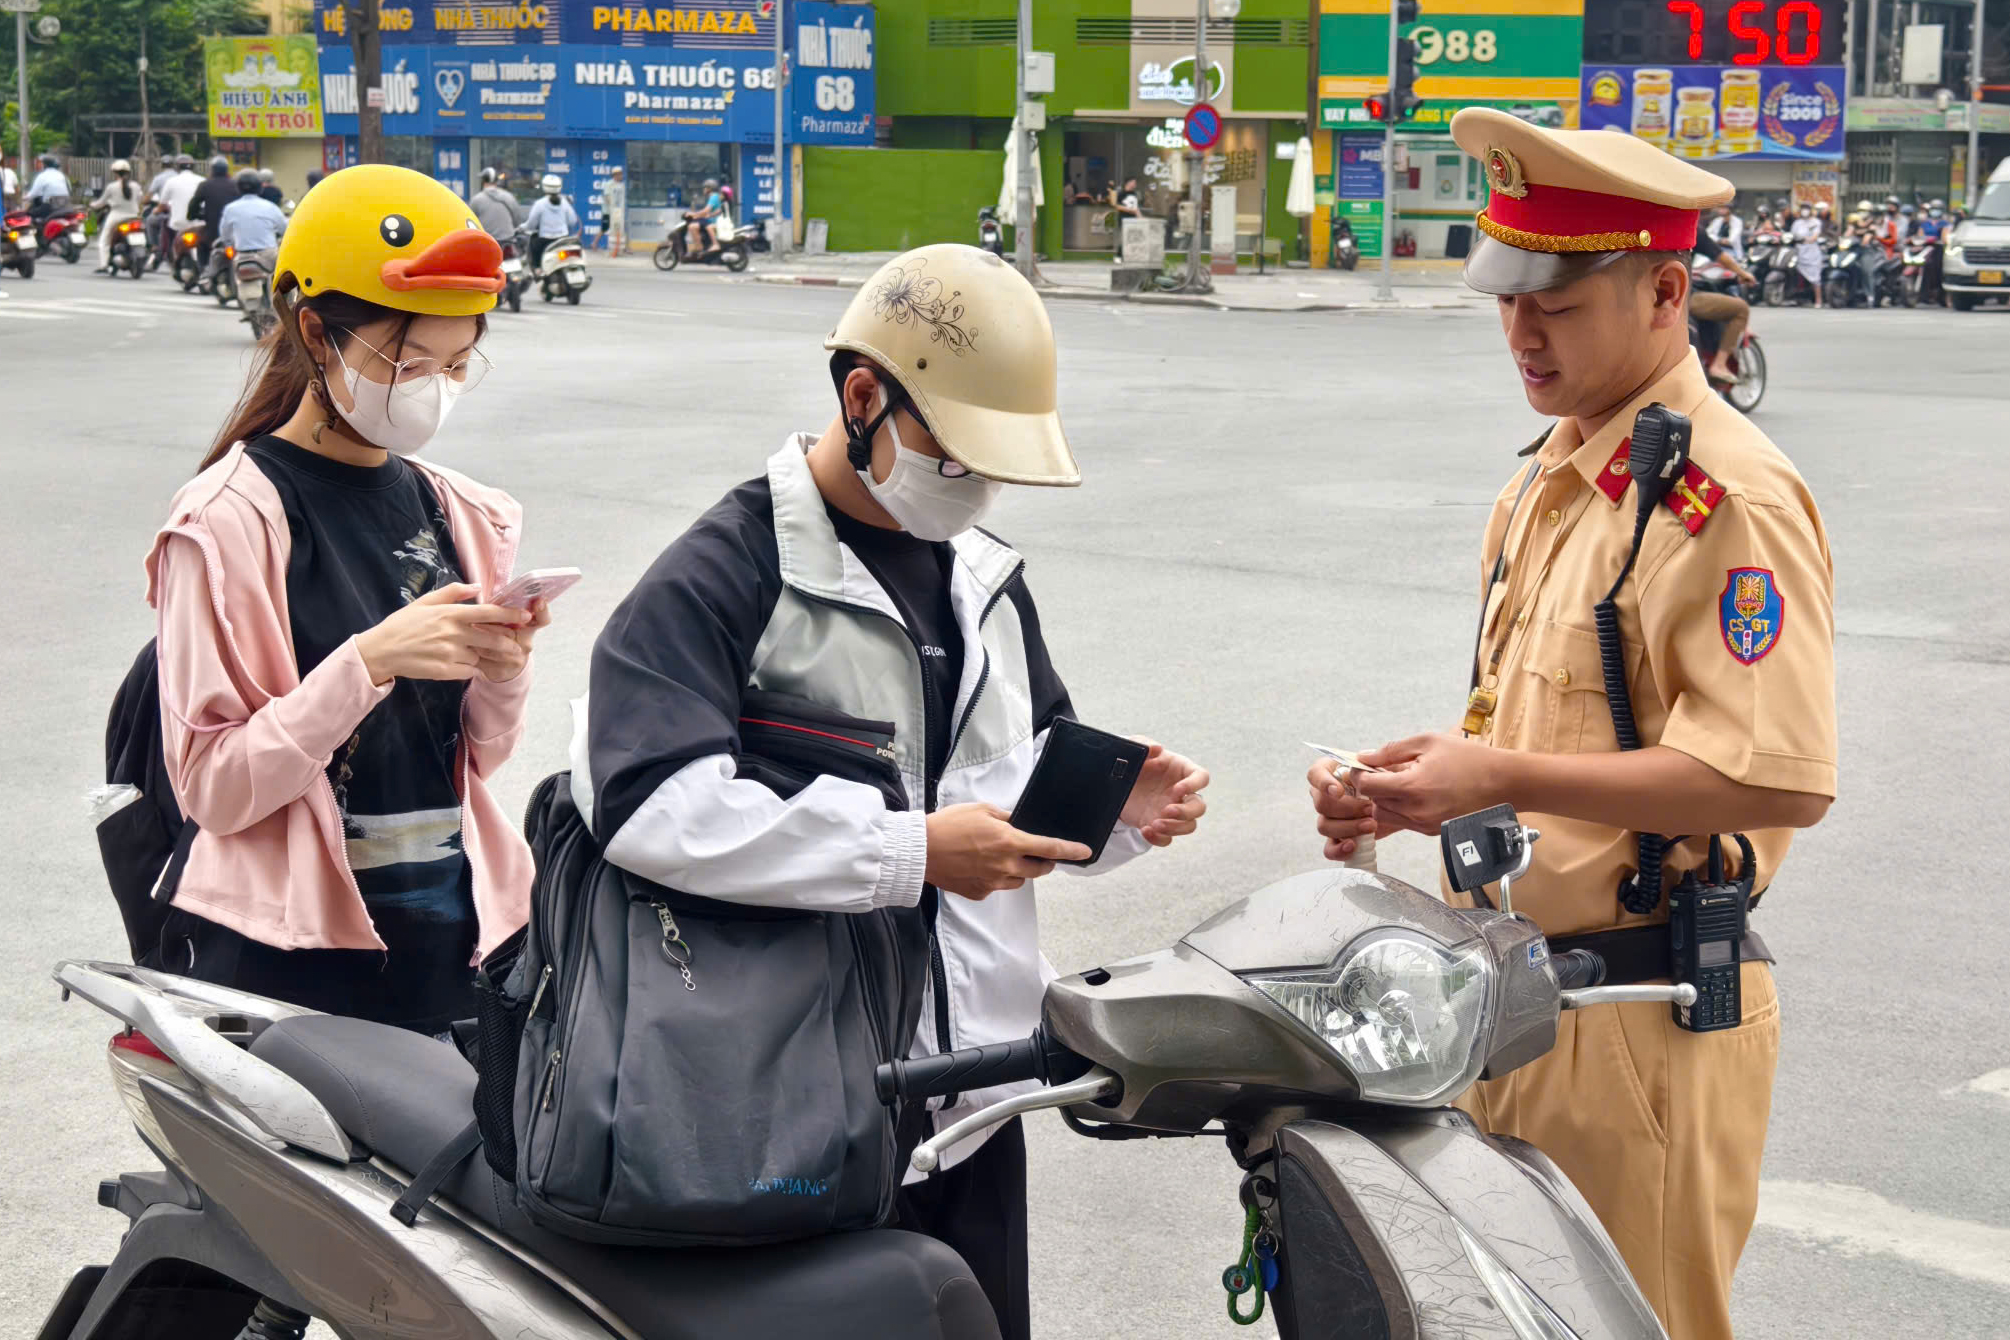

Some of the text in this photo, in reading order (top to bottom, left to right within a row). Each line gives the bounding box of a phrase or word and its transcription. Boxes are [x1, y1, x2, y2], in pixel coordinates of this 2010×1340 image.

[592, 6, 758, 35] PHARMAZA
[1667, 0, 1704, 60] 7
[574, 59, 777, 90] NHÀ THUỐC 68
[381, 58, 420, 114] UỐC
[815, 75, 855, 112] 68
[222, 88, 264, 109] HIỆU
[624, 91, 726, 111] Pharmaza
[1781, 92, 1823, 106] Since
[1779, 106, 1823, 121] 2009
[801, 115, 865, 135] Pharmaza
[1728, 618, 1770, 633] CS GT
[1462, 845, 1474, 857] FI
